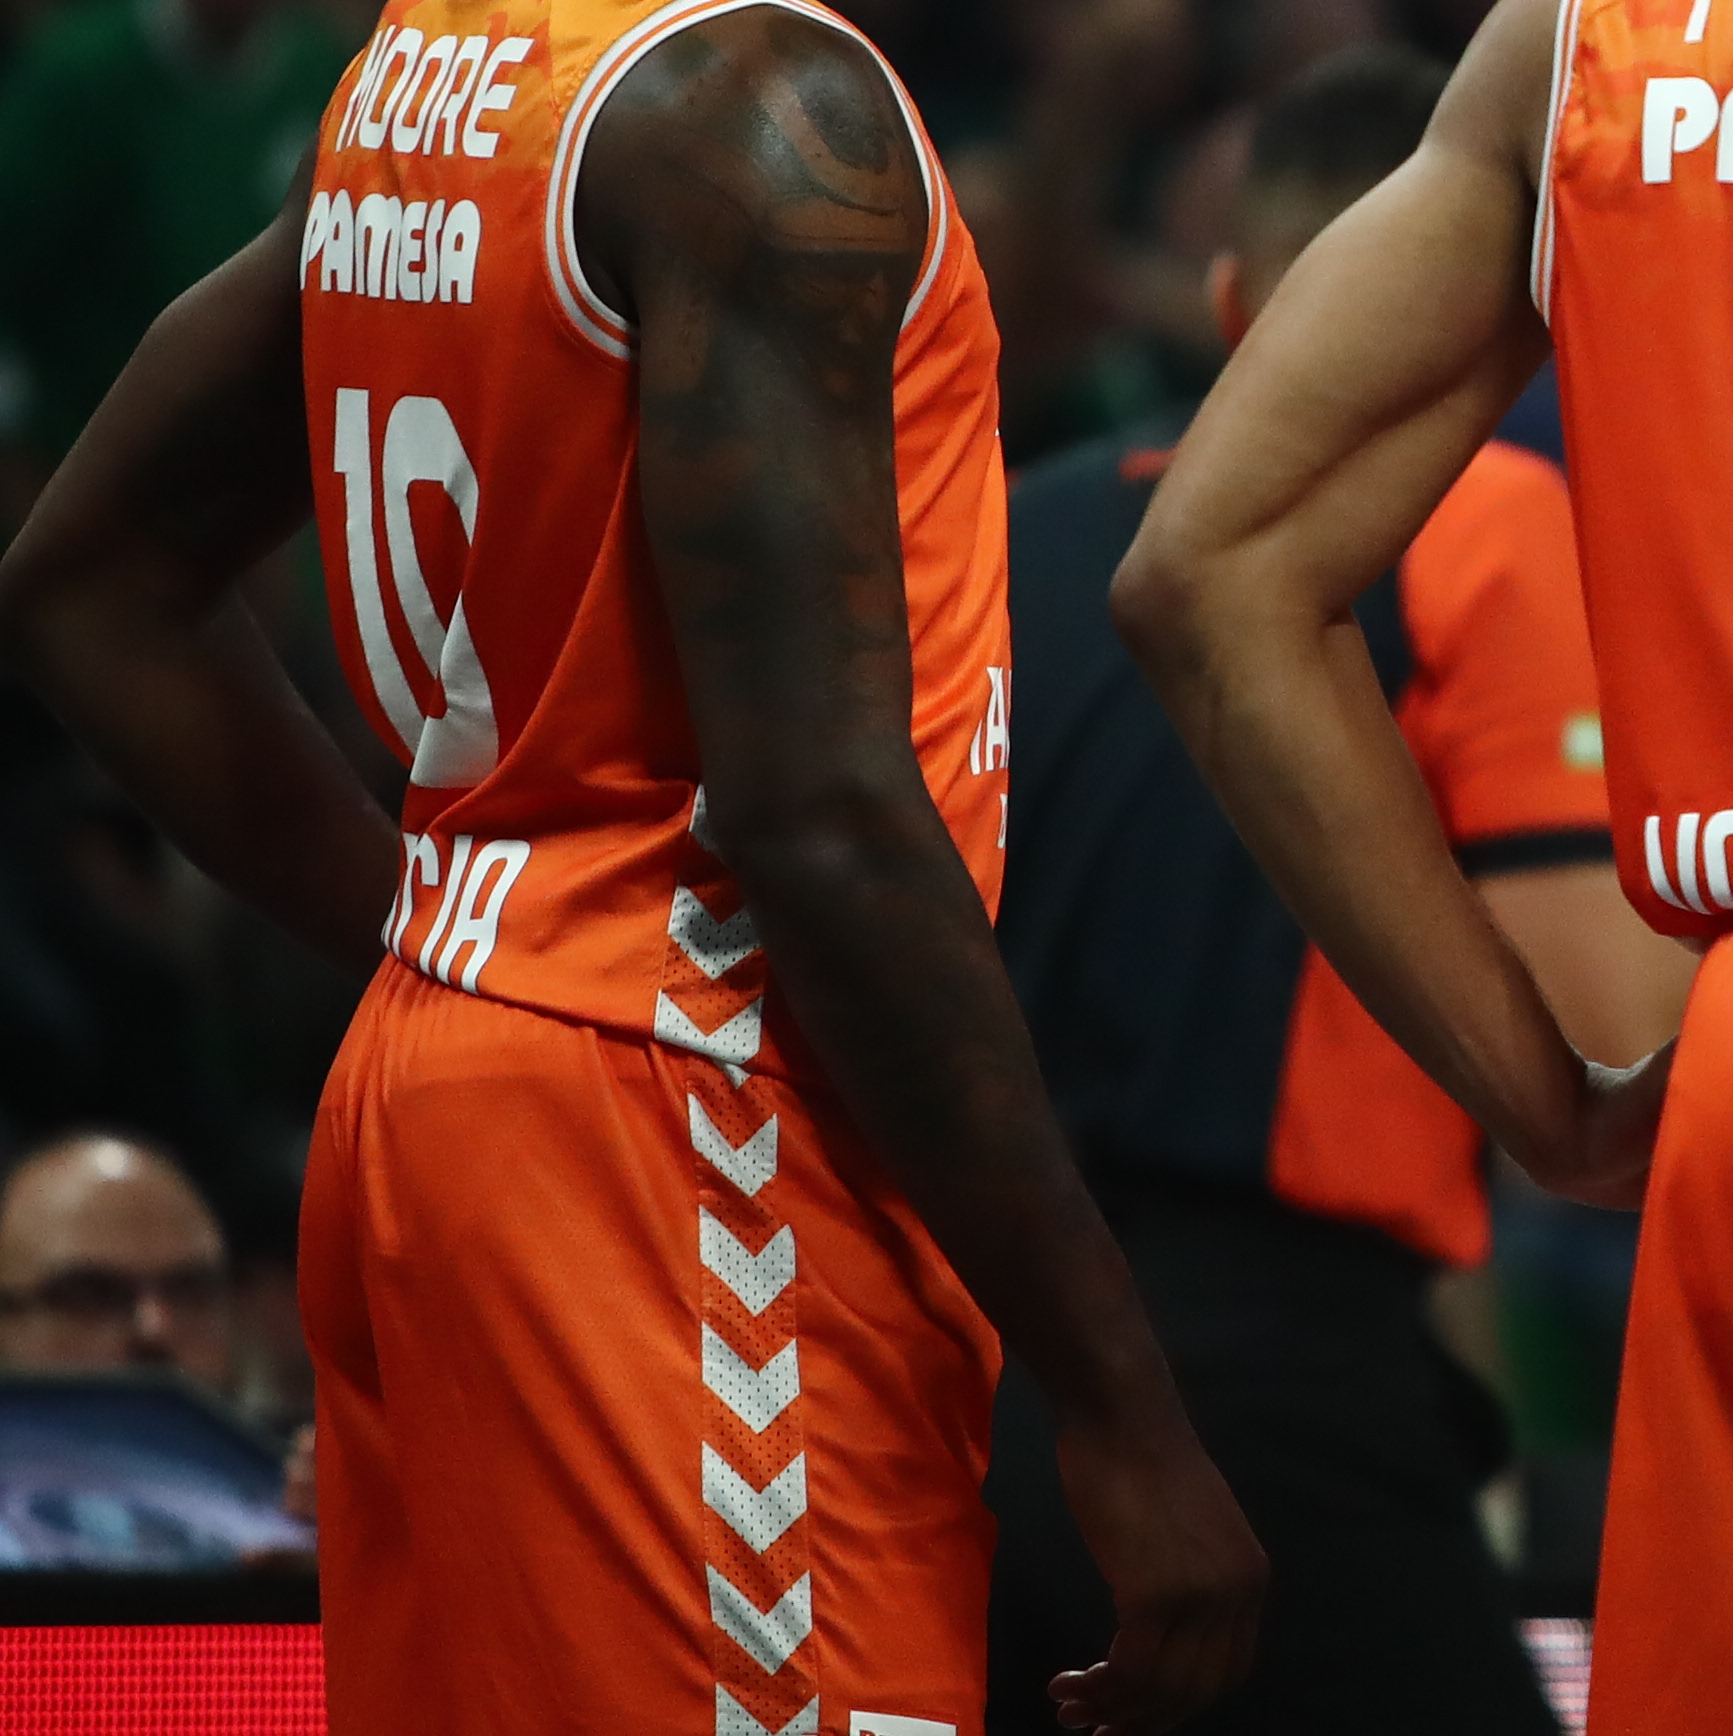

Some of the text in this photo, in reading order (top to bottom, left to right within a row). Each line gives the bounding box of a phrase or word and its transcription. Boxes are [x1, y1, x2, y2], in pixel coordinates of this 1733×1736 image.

[335, 24, 536, 159] MOORE
[300, 188, 482, 304] PAMESA
[333, 386, 500, 790] 10
